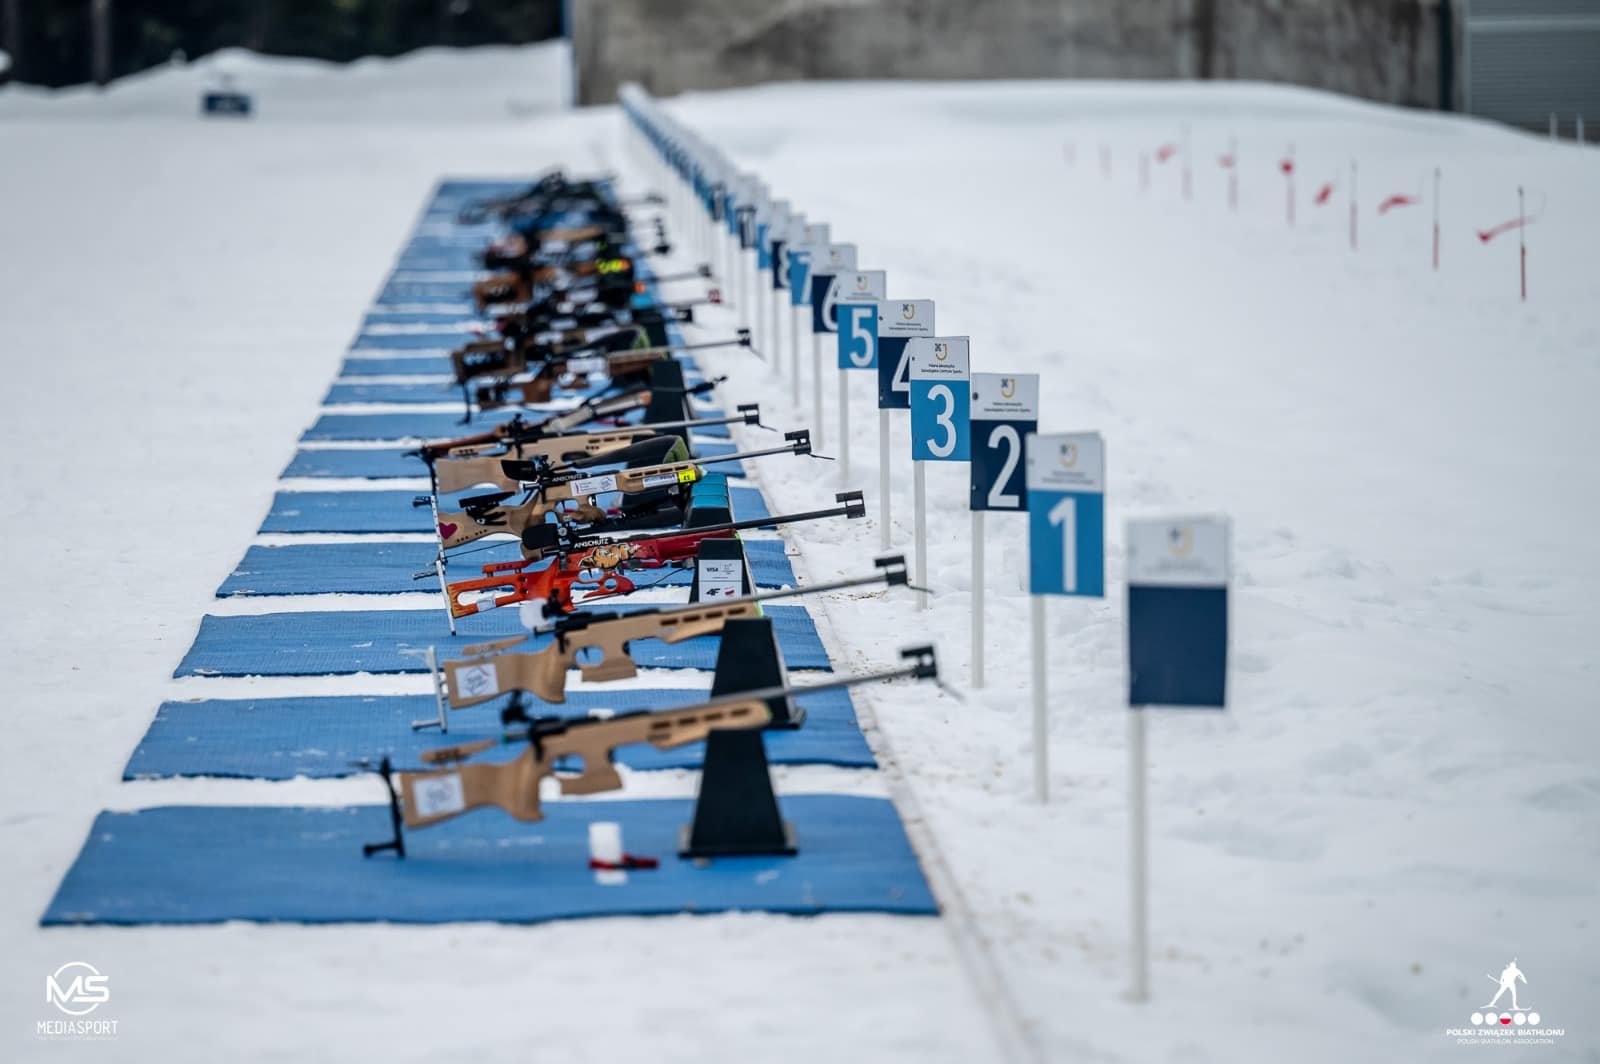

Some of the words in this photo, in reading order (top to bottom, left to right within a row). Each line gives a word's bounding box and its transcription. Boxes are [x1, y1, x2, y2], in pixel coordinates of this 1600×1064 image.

[849, 307, 875, 368] 5
[926, 384, 957, 458] 3
[987, 424, 1021, 508] 2
[1047, 496, 1078, 593] 1
